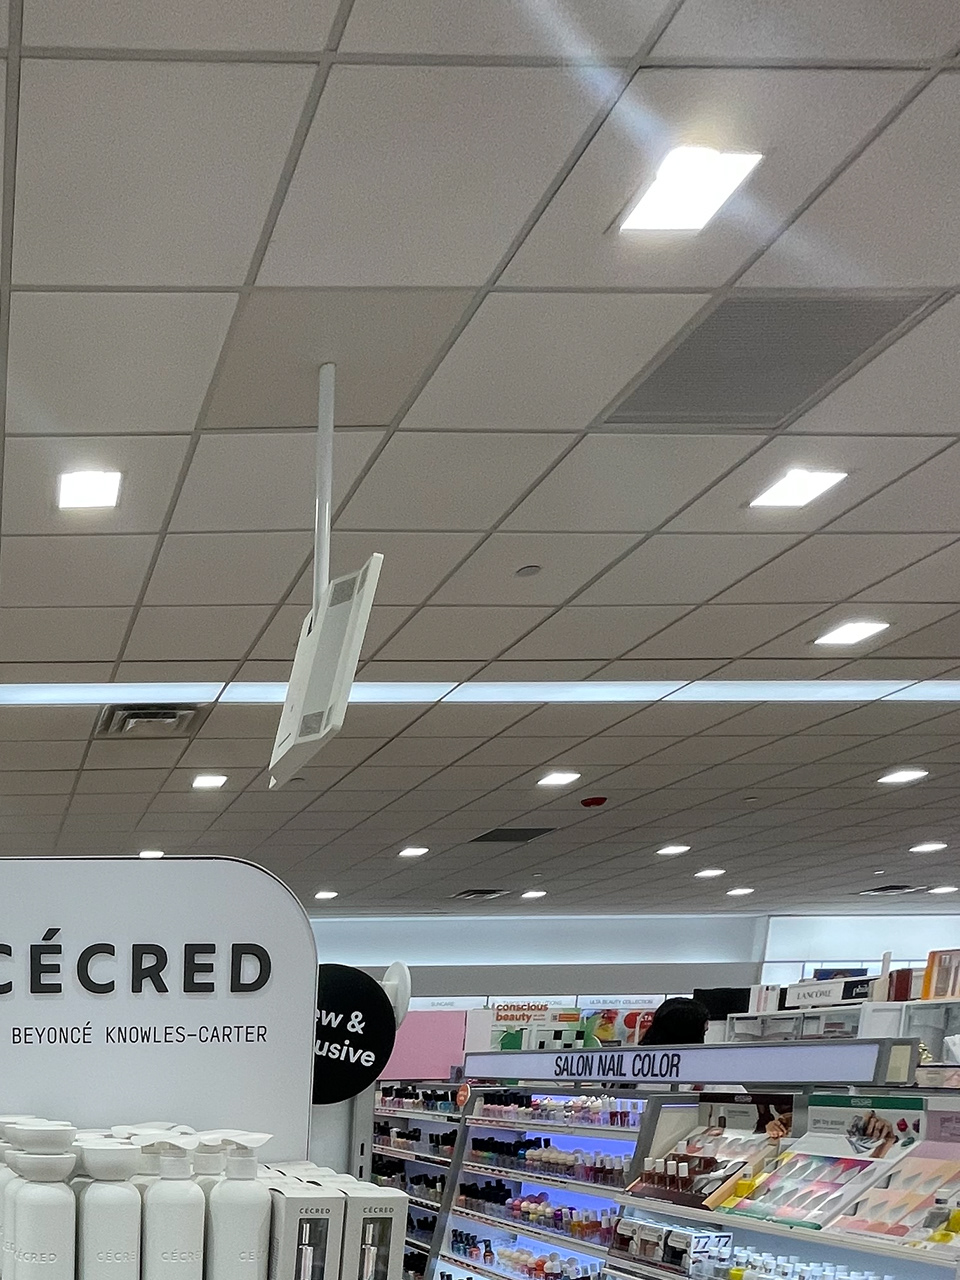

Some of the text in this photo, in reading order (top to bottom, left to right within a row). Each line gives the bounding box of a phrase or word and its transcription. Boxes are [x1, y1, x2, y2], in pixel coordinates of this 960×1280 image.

[496, 1003, 548, 1012] conscious
[496, 1012, 532, 1023] beauty
[12, 1022, 93, 1044] BEYONCÉ
[106, 1026, 268, 1044] KNOWLES-CARTER
[314, 1040, 376, 1067] usive
[554, 1053, 682, 1078] SALON NAIL COLOR
[362, 1206, 394, 1214] CÉCRED
[96, 1249, 136, 1263] CÉCRE
